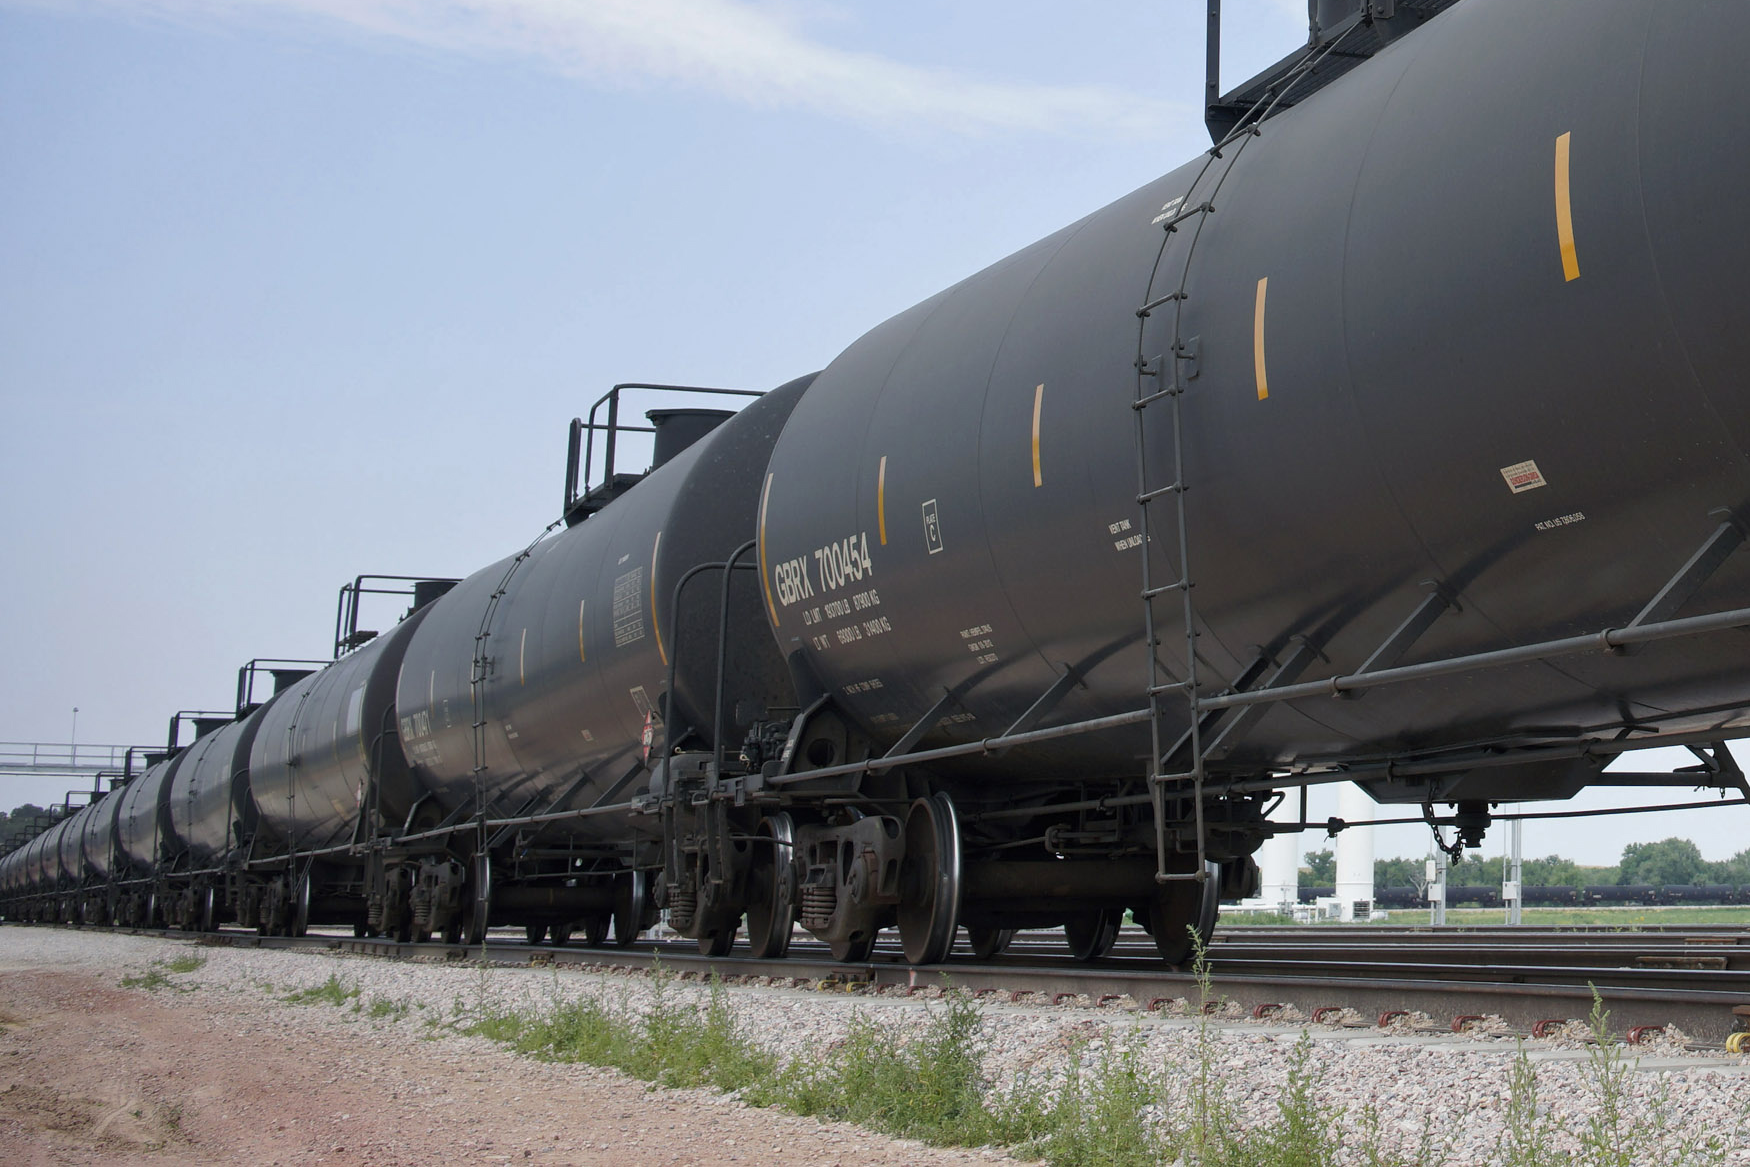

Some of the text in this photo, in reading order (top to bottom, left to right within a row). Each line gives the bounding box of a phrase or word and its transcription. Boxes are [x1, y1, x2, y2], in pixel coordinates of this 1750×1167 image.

[929, 524, 937, 542] C
[774, 531, 873, 607] GBRX 700454
